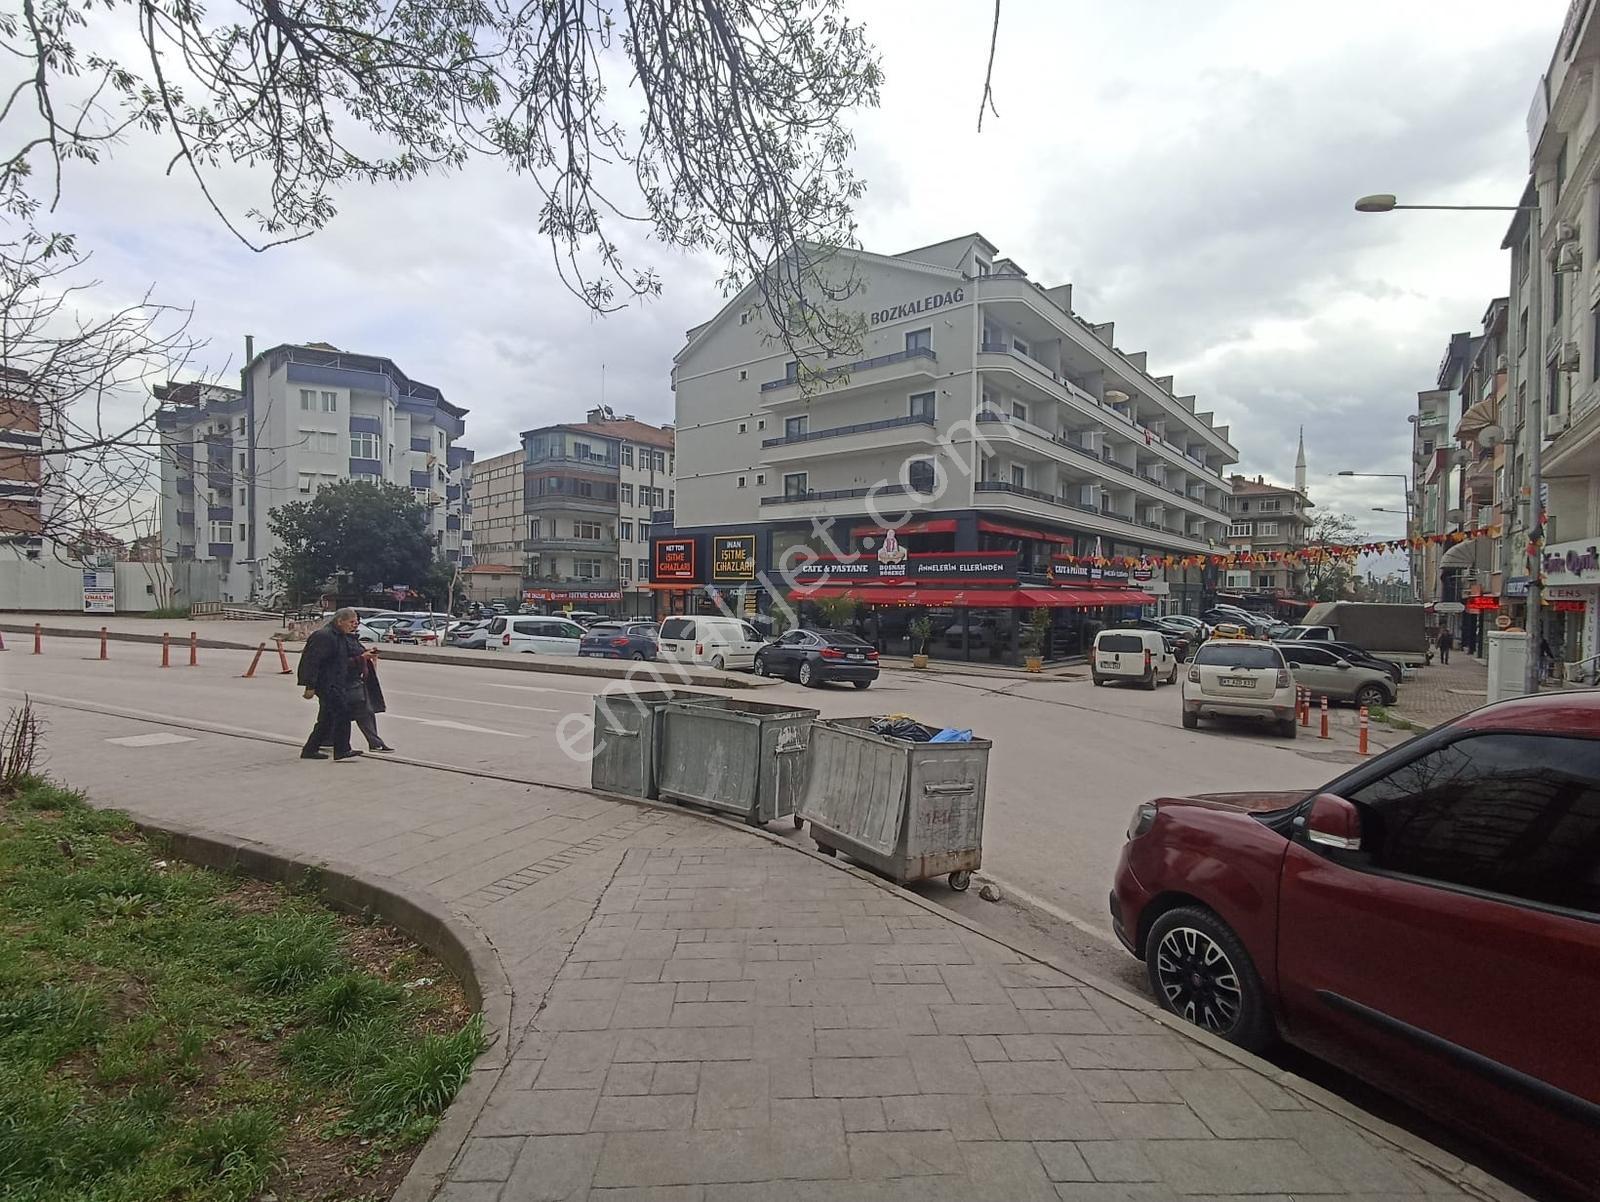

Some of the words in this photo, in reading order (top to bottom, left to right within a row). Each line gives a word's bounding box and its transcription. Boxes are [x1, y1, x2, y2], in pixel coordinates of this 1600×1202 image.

[823, 564, 831, 573] &
[831, 564, 869, 573] PASTANE
[959, 563, 1004, 572] ELLERİNDEN
[1549, 589, 1581, 598] LENS
